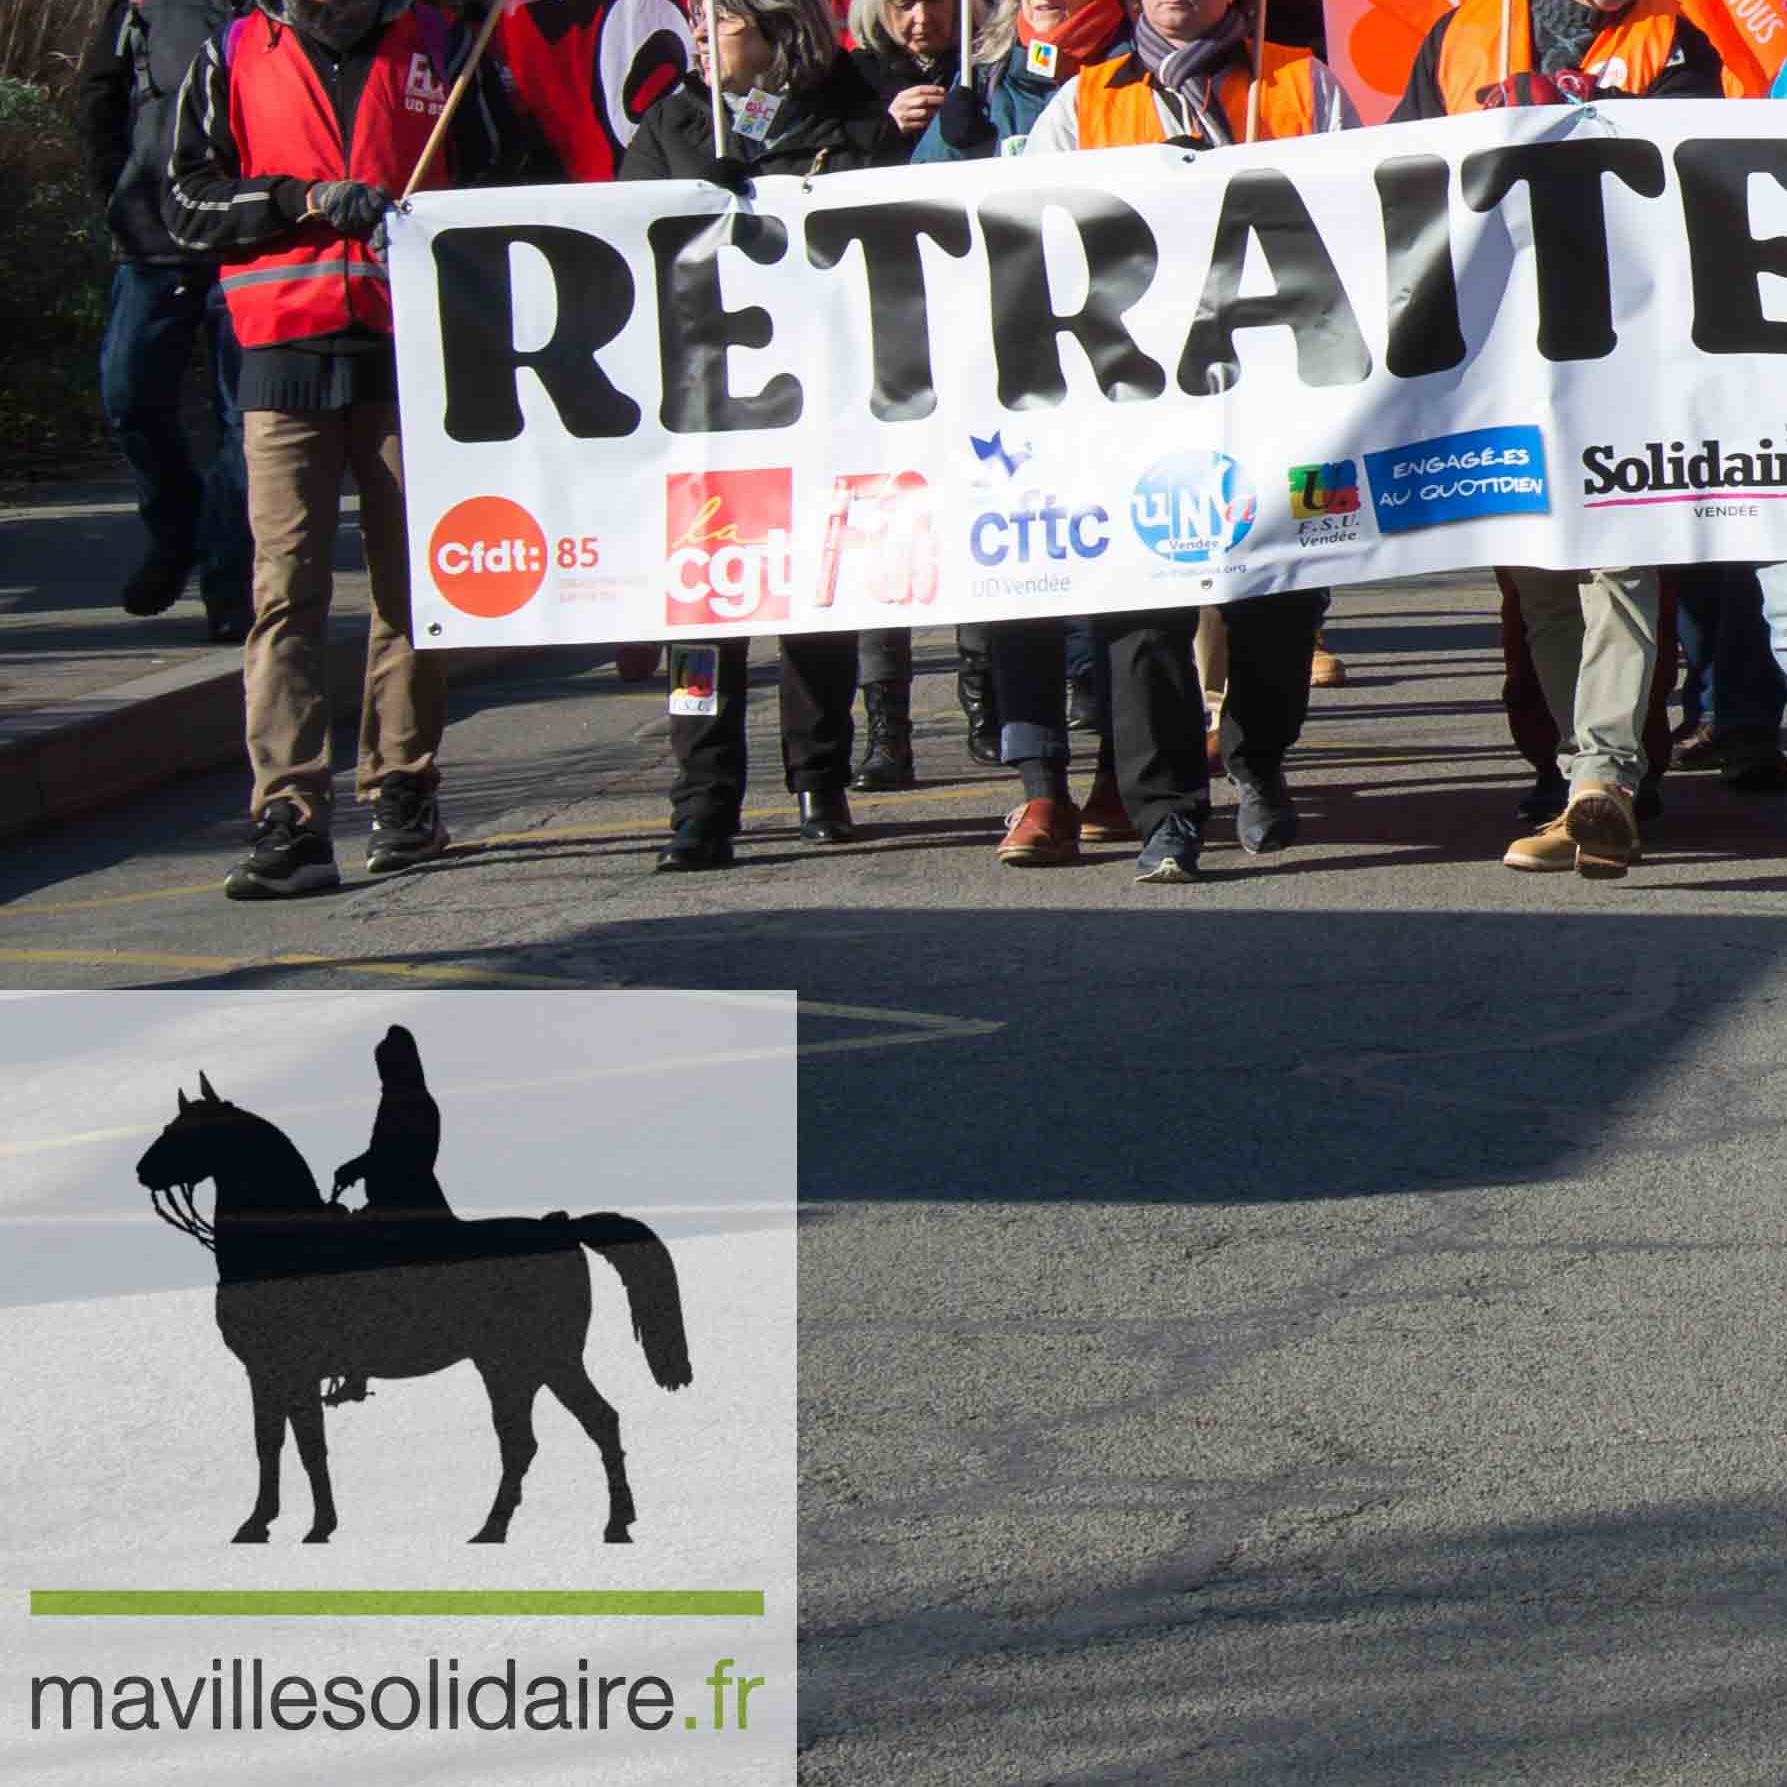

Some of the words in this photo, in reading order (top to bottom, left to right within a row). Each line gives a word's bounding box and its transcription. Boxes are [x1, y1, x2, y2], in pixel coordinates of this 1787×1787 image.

[1379, 489, 1413, 508] AU
[1420, 475, 1544, 501] QUOTIDIEN
[557, 537, 599, 569] 85
[1298, 530, 1358, 548] Vendée
[666, 528, 792, 618] cgt
